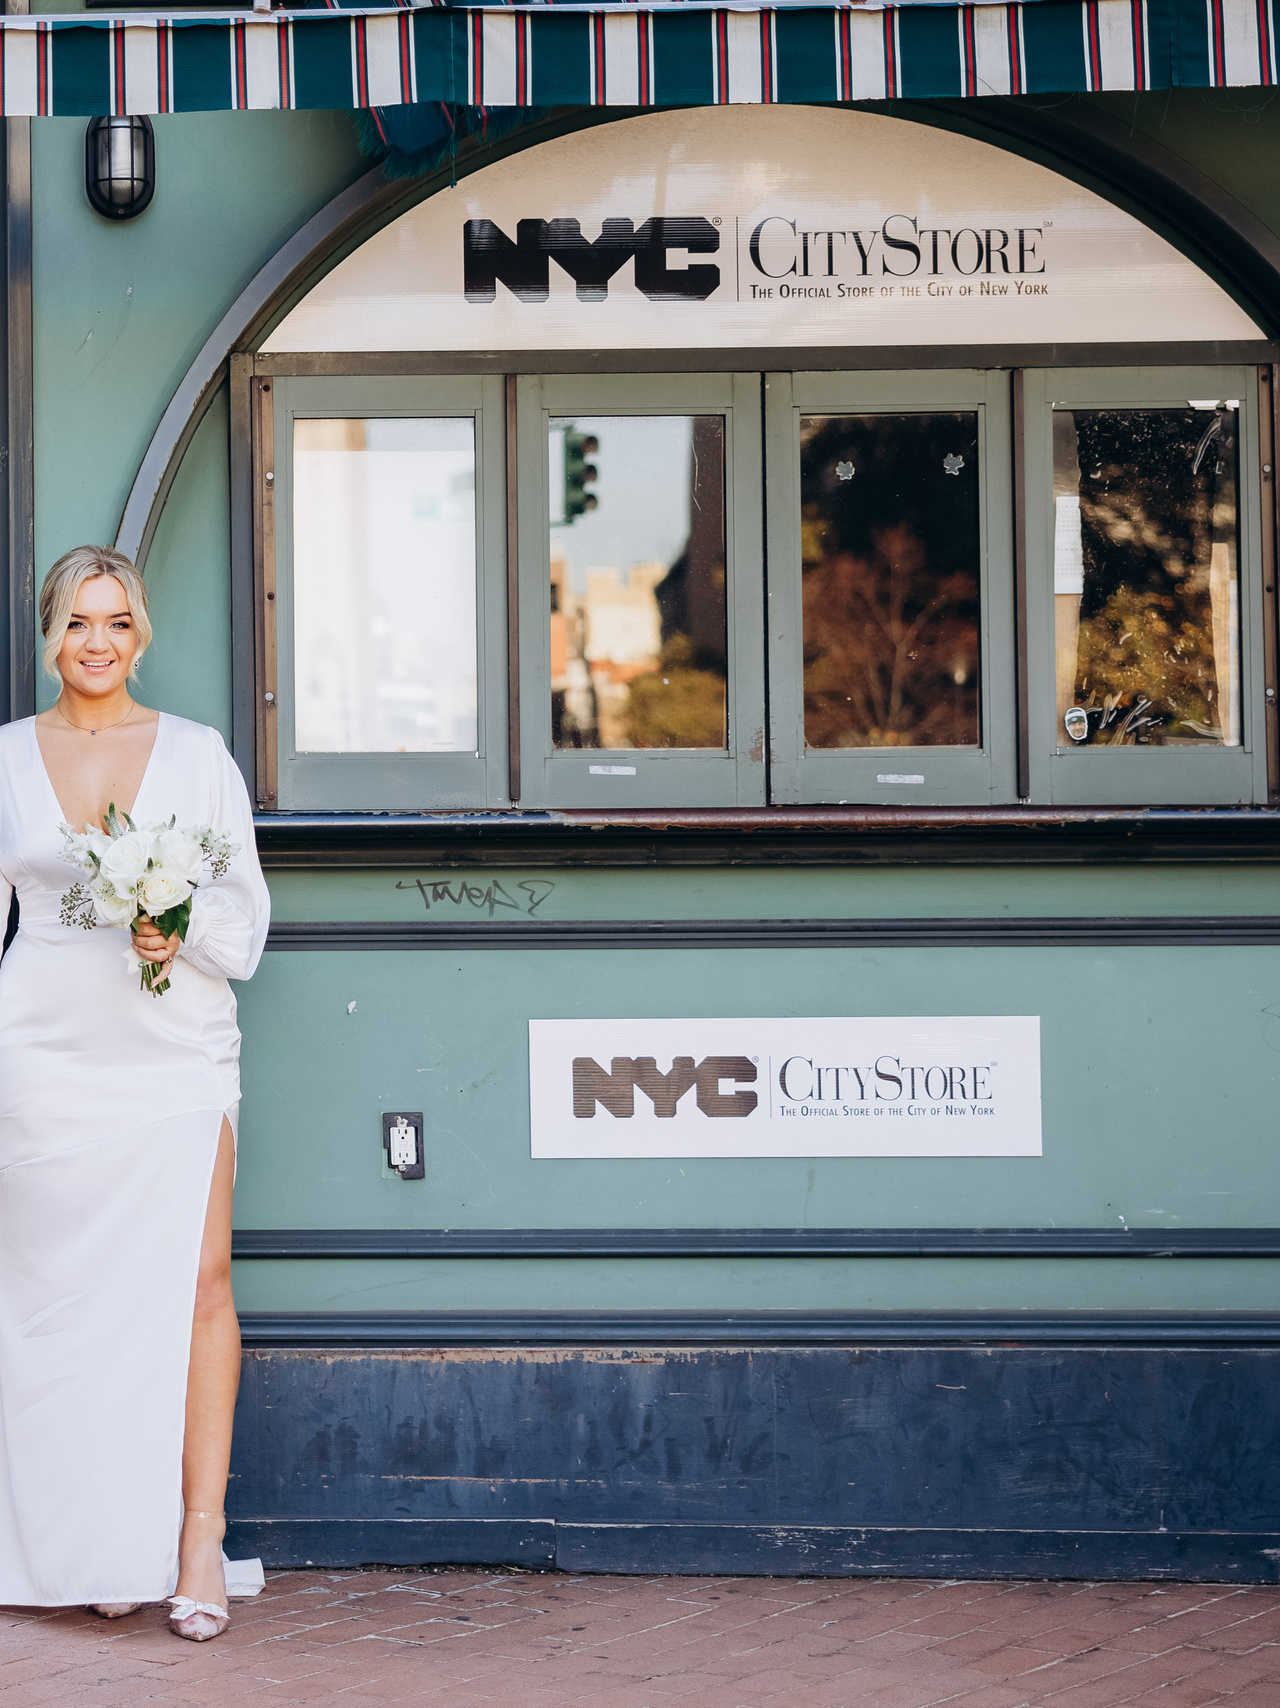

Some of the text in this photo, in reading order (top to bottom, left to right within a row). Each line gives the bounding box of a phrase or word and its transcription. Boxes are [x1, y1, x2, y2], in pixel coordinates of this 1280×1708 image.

[463, 217, 720, 303] NYC
[749, 215, 1045, 278] CITYSTORE
[750, 281, 1048, 298] THE OFFICIAL STORE OF THE CITY OF NEW YORK
[572, 1056, 758, 1118] NYC
[779, 1056, 992, 1101] CITYSTORE
[779, 1106, 796, 1116] THE
[801, 1106, 838, 1116] OFFICIAL
[843, 1105, 869, 1116] STORE
[874, 1108, 884, 1116] OF
[908, 1105, 926, 1115] CITY
[946, 1105, 966, 1115] NEW
[970, 1105, 994, 1115] YORK
